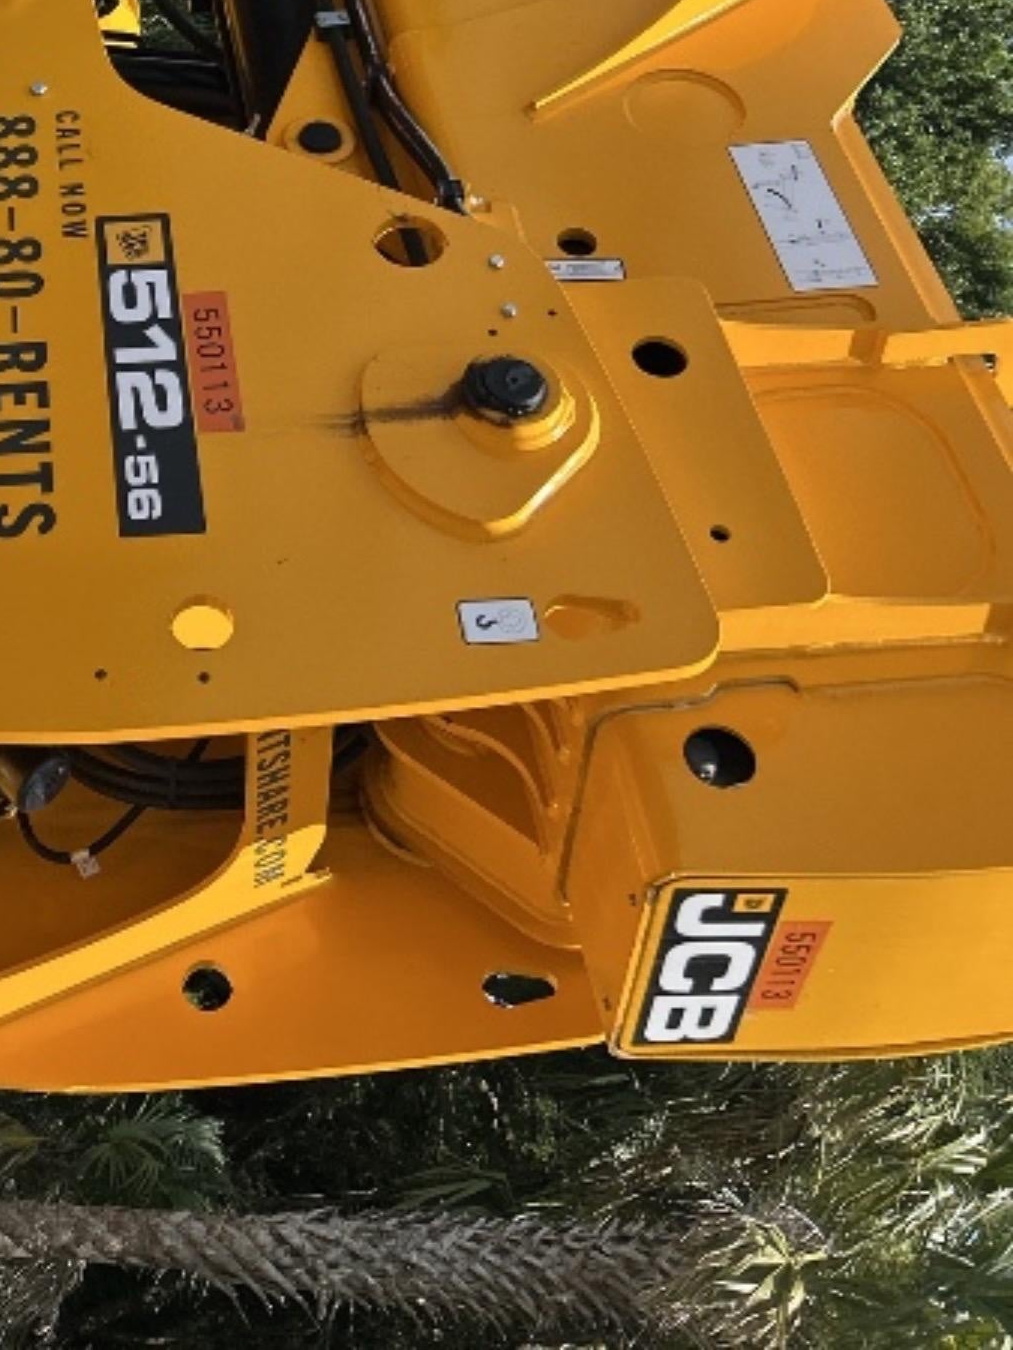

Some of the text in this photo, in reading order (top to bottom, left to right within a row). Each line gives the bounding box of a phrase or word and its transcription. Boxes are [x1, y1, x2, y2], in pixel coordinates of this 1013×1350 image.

[56, 110, 88, 240] CALL NOW
[108, 268, 184, 521] 512-56
[191, 307, 234, 416] 550113
[643, 893, 767, 1044] JCB
[760, 931, 817, 1001] 550113
